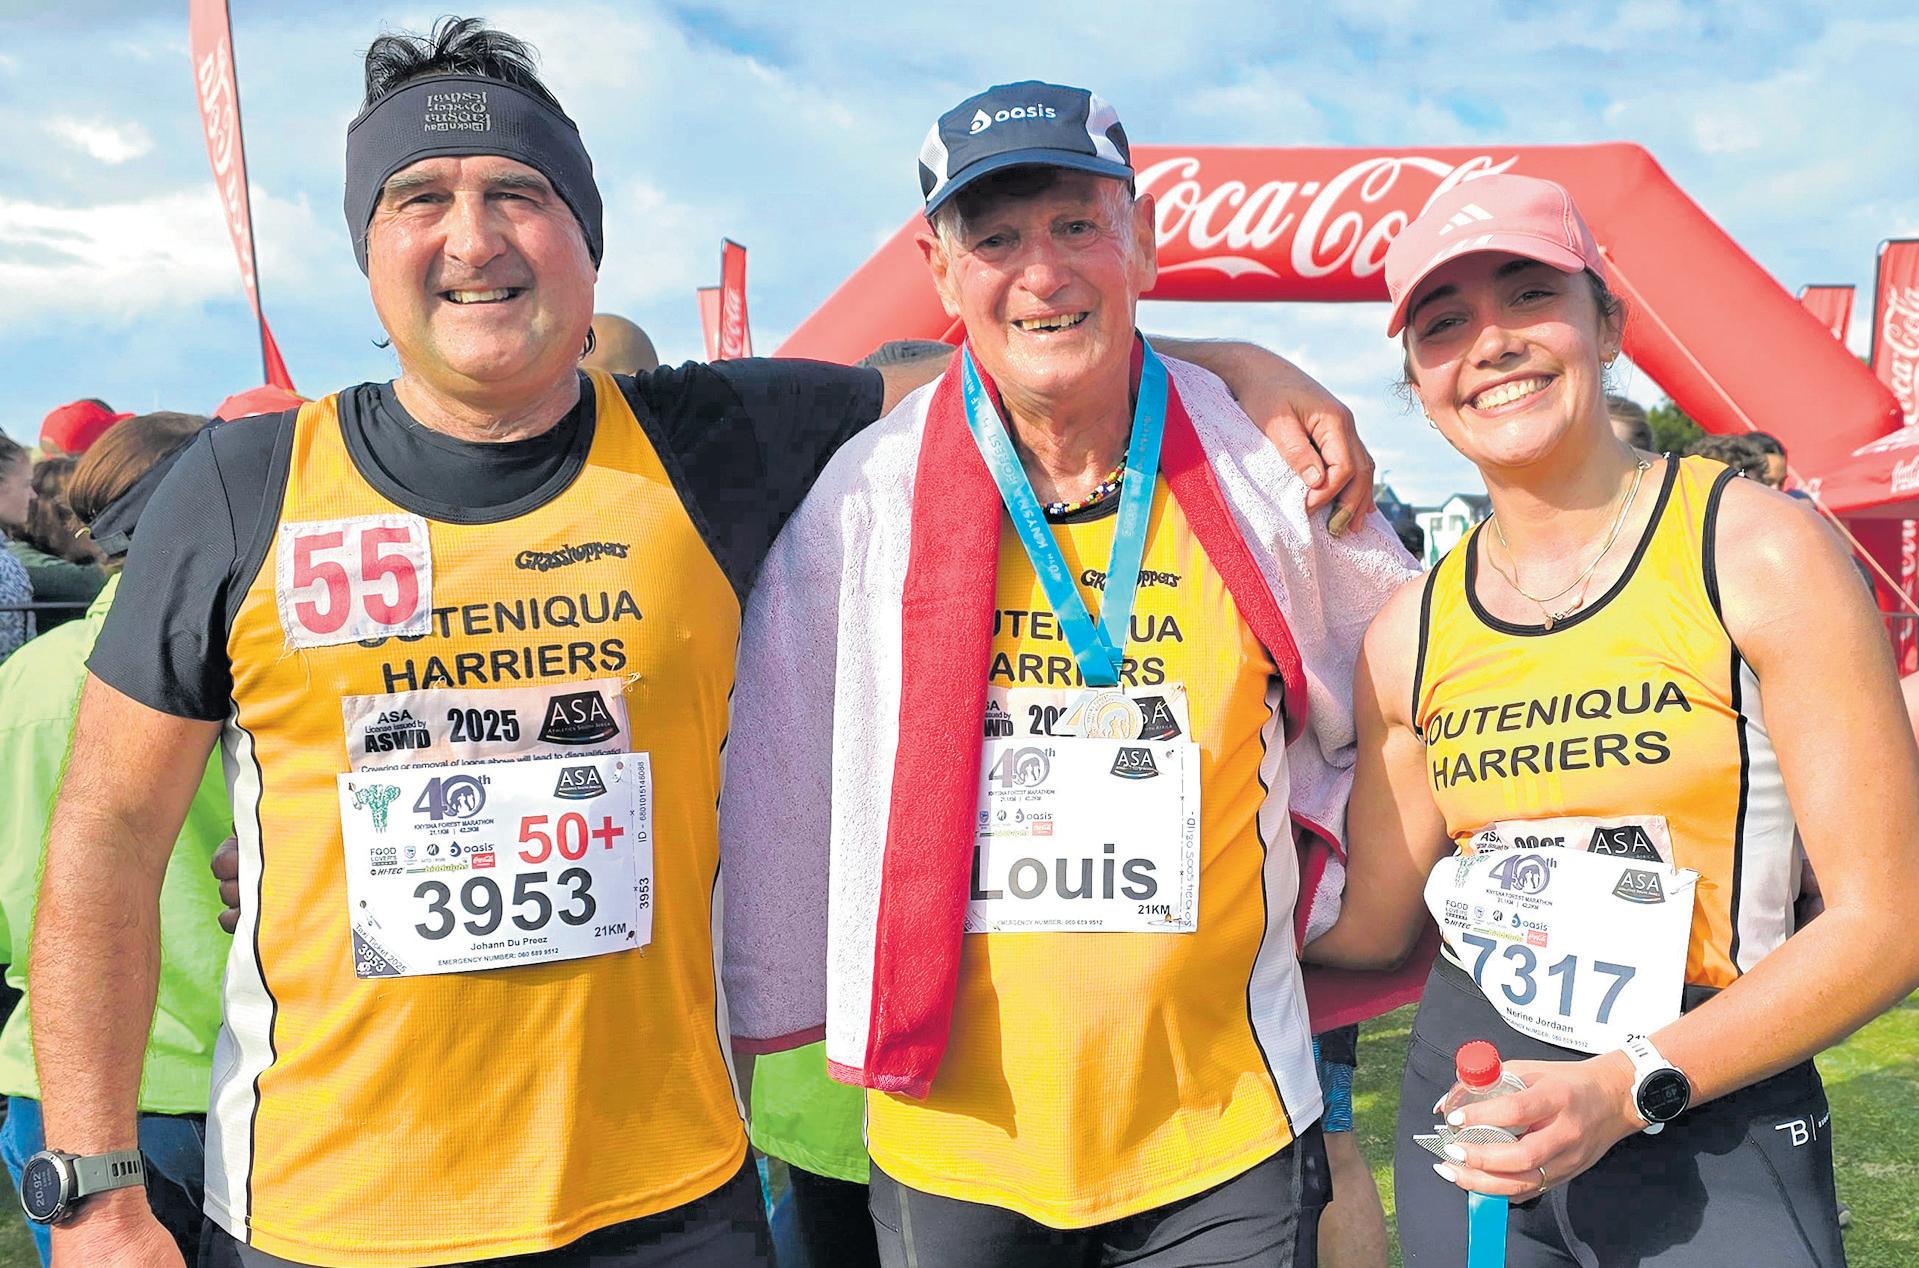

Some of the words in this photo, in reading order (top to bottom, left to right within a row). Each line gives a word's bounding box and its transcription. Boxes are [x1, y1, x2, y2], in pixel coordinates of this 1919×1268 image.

[994, 103, 1057, 122] oasis
[1135, 154, 1519, 278] Coca-Col
[293, 526, 420, 635] 55
[358, 590, 643, 648] TENIQUA
[383, 638, 627, 694] HARRIERS
[377, 709, 413, 725] ASA
[550, 697, 607, 727] ASA
[1429, 682, 1692, 745] OUTENIQUA
[393, 721, 416, 730] issued
[417, 719, 427, 729] by
[447, 708, 520, 743] 2025
[365, 729, 431, 753] ASWD
[1117, 750, 1153, 767] ASA
[1433, 731, 1671, 791] HARRIERS
[560, 769, 600, 787] ASA
[1026, 812, 1053, 820] oasis
[463, 843, 494, 853] oasis
[518, 812, 624, 864] 50+
[638, 831, 648, 843] ID
[1594, 832, 1651, 855] ASA
[970, 843, 1158, 901] Louis
[1621, 872, 1660, 892] ASA
[413, 867, 597, 940] 3953
[639, 877, 650, 910] 3953
[1138, 904, 1170, 916] 21KM
[594, 923, 627, 938] 21KM
[1523, 920, 1548, 931] oasis
[470, 941, 505, 951] Johann
[507, 938, 520, 947] Du
[358, 943, 387, 973] 3953
[387, 955, 408, 973] 2025
[438, 957, 483, 966] EMERGENCY
[483, 953, 516, 962] NUMBER:
[1462, 932, 1636, 1024] 7317
[1506, 1007, 1533, 1023] Nerine
[1535, 1017, 1574, 1034] Jordaan
